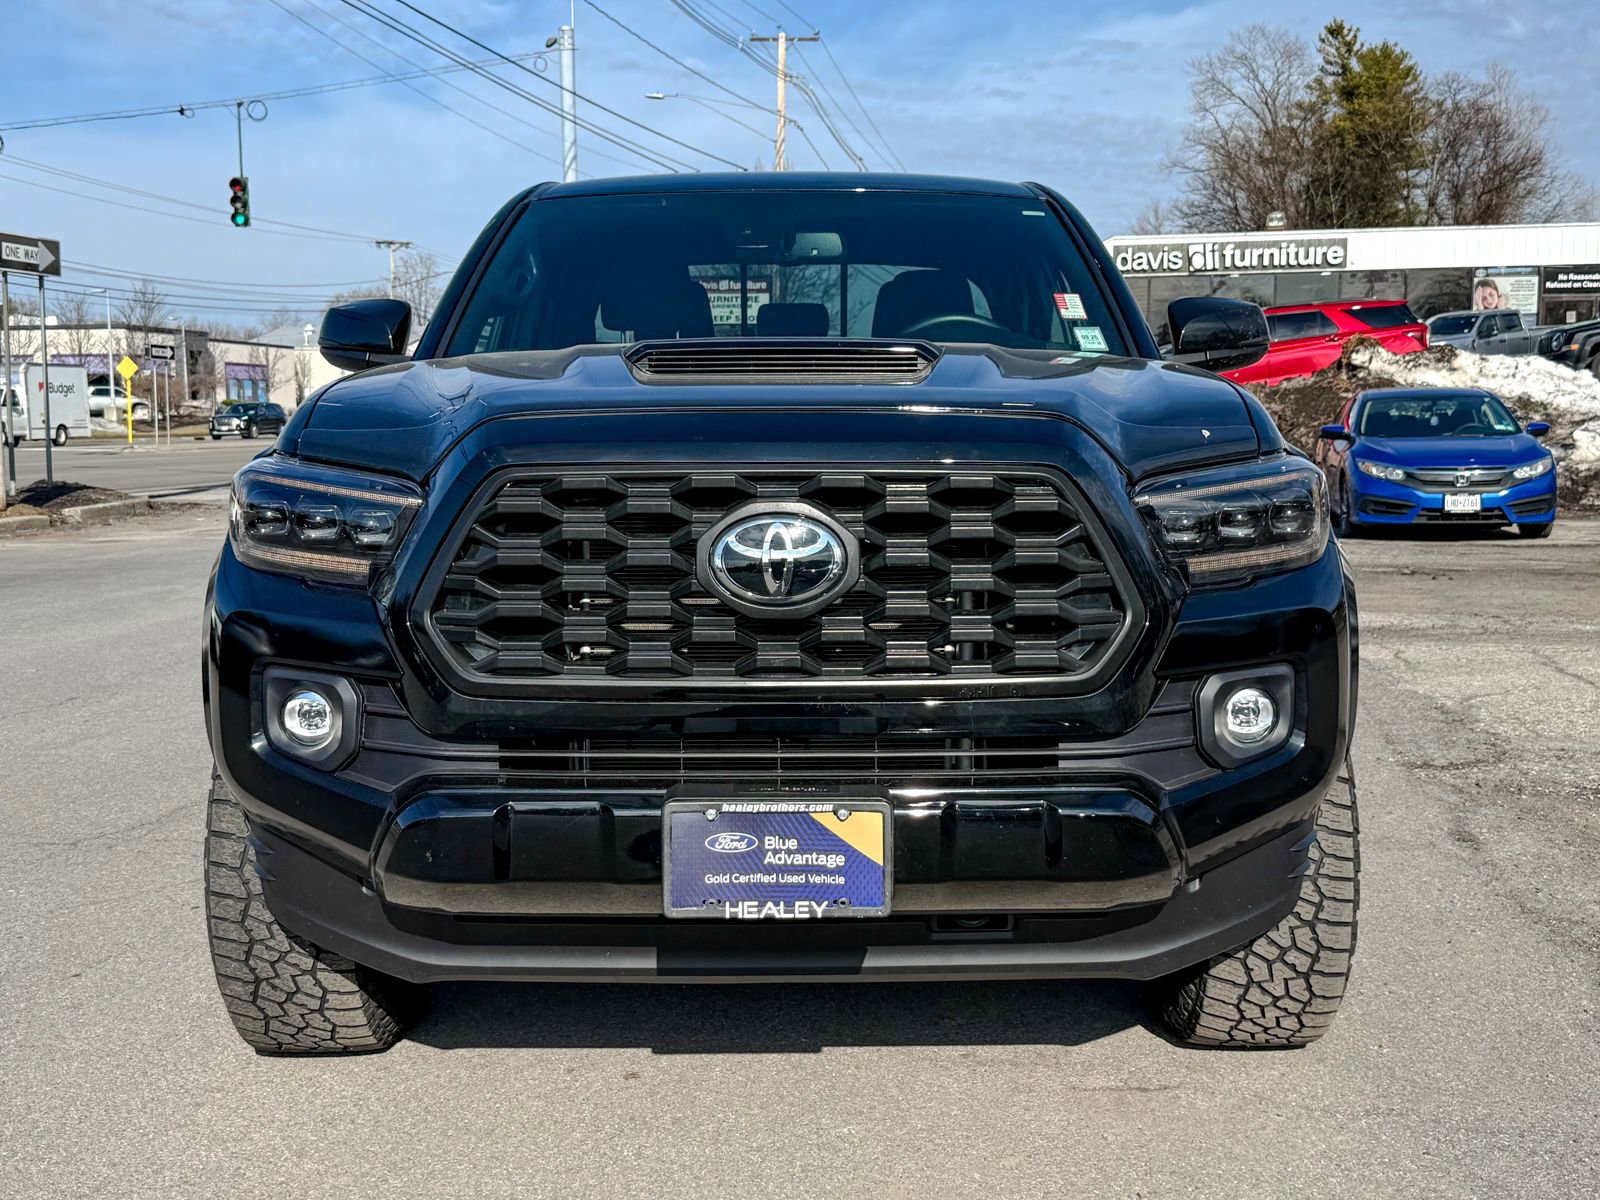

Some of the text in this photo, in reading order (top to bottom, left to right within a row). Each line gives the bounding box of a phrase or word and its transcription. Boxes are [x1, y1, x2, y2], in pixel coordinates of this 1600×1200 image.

[5, 245, 39, 261] ONE WAY
[1116, 246, 1183, 271] davis
[1222, 242, 1345, 268] furniture
[1546, 281, 1571, 289] Refused
[709, 295, 760, 303] URNITRE
[48, 382, 75, 397] Budget
[722, 803, 834, 814] healeybrothers.com
[715, 835, 798, 850] Ford Blue
[764, 851, 846, 868] Advantage
[705, 873, 845, 885] Gold Certified Used Vehicle
[725, 901, 829, 919] HEALEY
